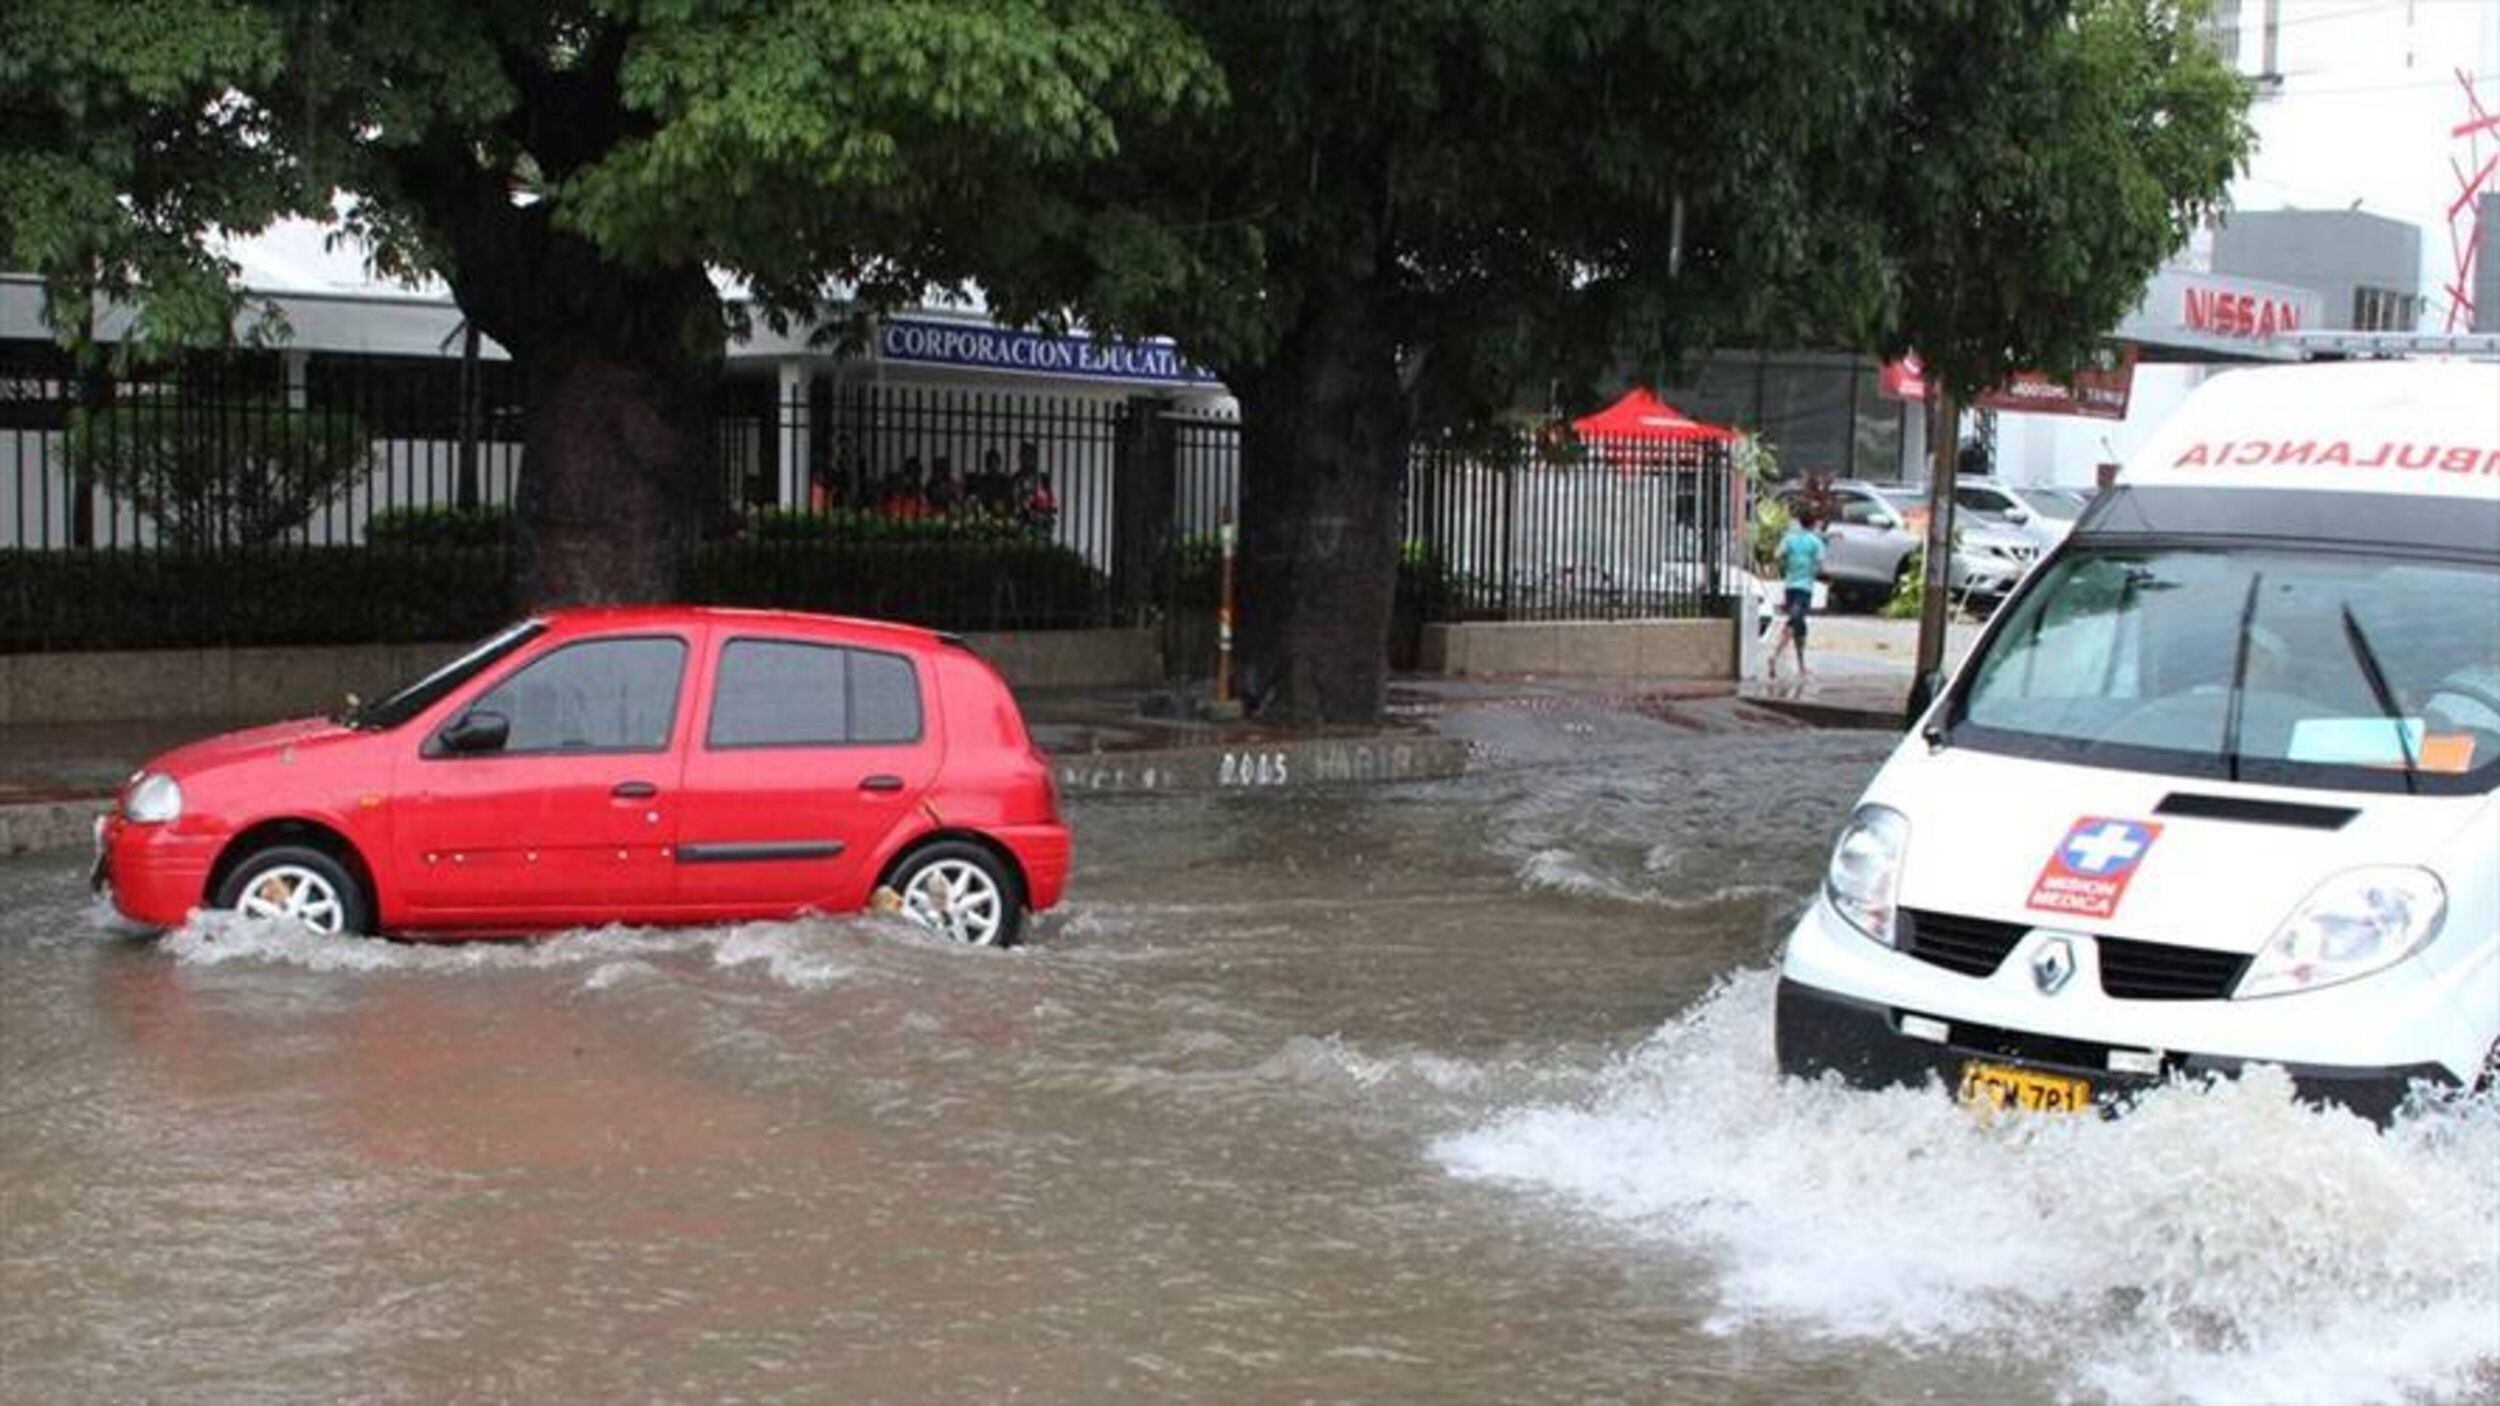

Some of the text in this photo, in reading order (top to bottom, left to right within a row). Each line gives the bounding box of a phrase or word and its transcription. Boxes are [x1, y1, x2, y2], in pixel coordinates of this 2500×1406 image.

[2184, 287, 2301, 339] NISSAN
[886, 325, 1072, 367] CORPORACION
[2033, 890, 2111, 913] MEDICA
